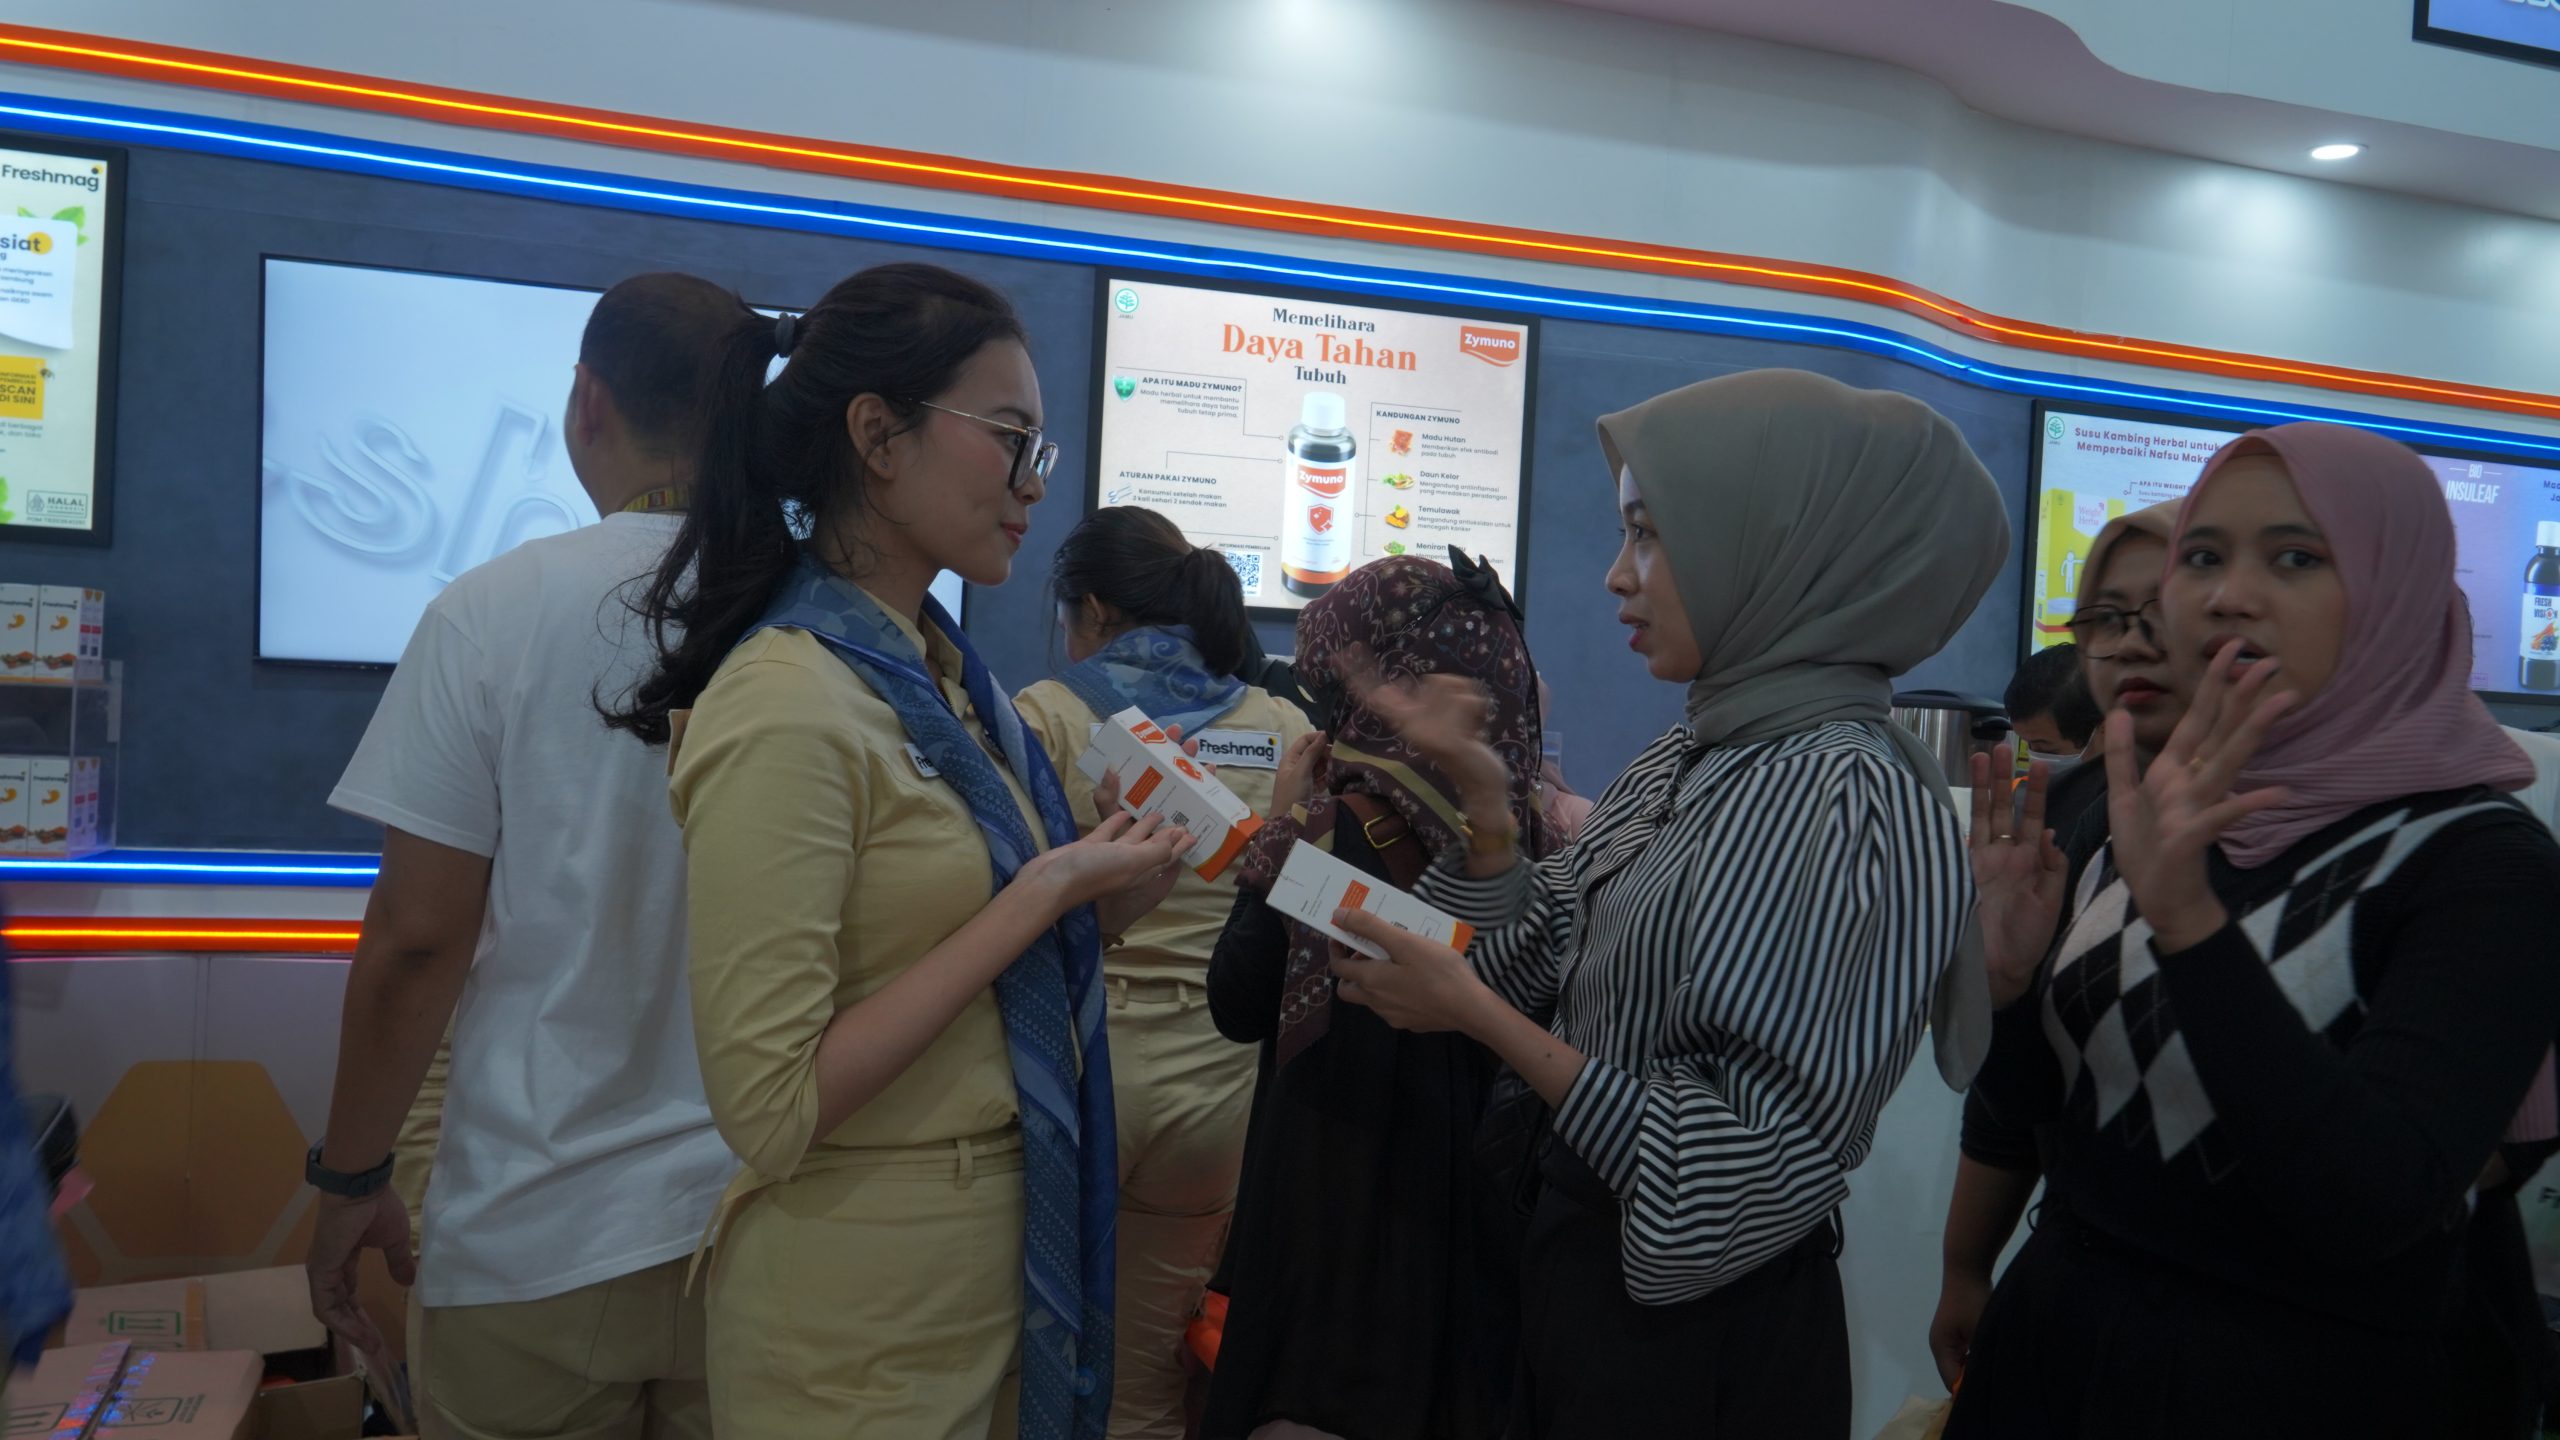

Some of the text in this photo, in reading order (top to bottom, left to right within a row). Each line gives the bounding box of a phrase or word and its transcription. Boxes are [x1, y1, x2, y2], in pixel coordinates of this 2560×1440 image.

[2, 164, 99, 192] Freshmag
[1273, 307, 1375, 333] Memelihara
[1222, 323, 1417, 371] Daya Tahan
[1464, 333, 1516, 349] Zymuno
[1294, 365, 1347, 385] Tubuh
[0, 384, 36, 395] SCAN
[1142, 377, 1242, 392] APA ITU MADU ZYMUNO?
[13, 395, 35, 404] SINI
[1140, 389, 1240, 403] Madu herbal untuk membantu
[1160, 399, 1239, 411] memelihara daya tahan
[1198, 409, 1216, 417] tetap
[1376, 410, 1460, 424] KANDUNGAN ZYMUNO
[1422, 433, 1442, 441] Madu
[2074, 427, 2221, 452] Susu Kambing Herbal untuk
[1421, 443, 1459, 452] Memberikan
[2076, 441, 2210, 464] Memperbaiki Nafsu Maka
[1120, 471, 1216, 484] ATURAN PAKAI ZYMUNO
[1299, 471, 1344, 484] Zymuno
[1420, 470, 1440, 478] Daun
[2468, 463, 2483, 479] BIO
[2445, 480, 2500, 504] INSULEAF
[48, 497, 84, 507] HALAL
[1418, 506, 1460, 514] Temulawak
[1416, 542, 1446, 551] Meniran
[2534, 597, 2552, 607] FRESH
[1199, 739, 1274, 761] Freshmag
